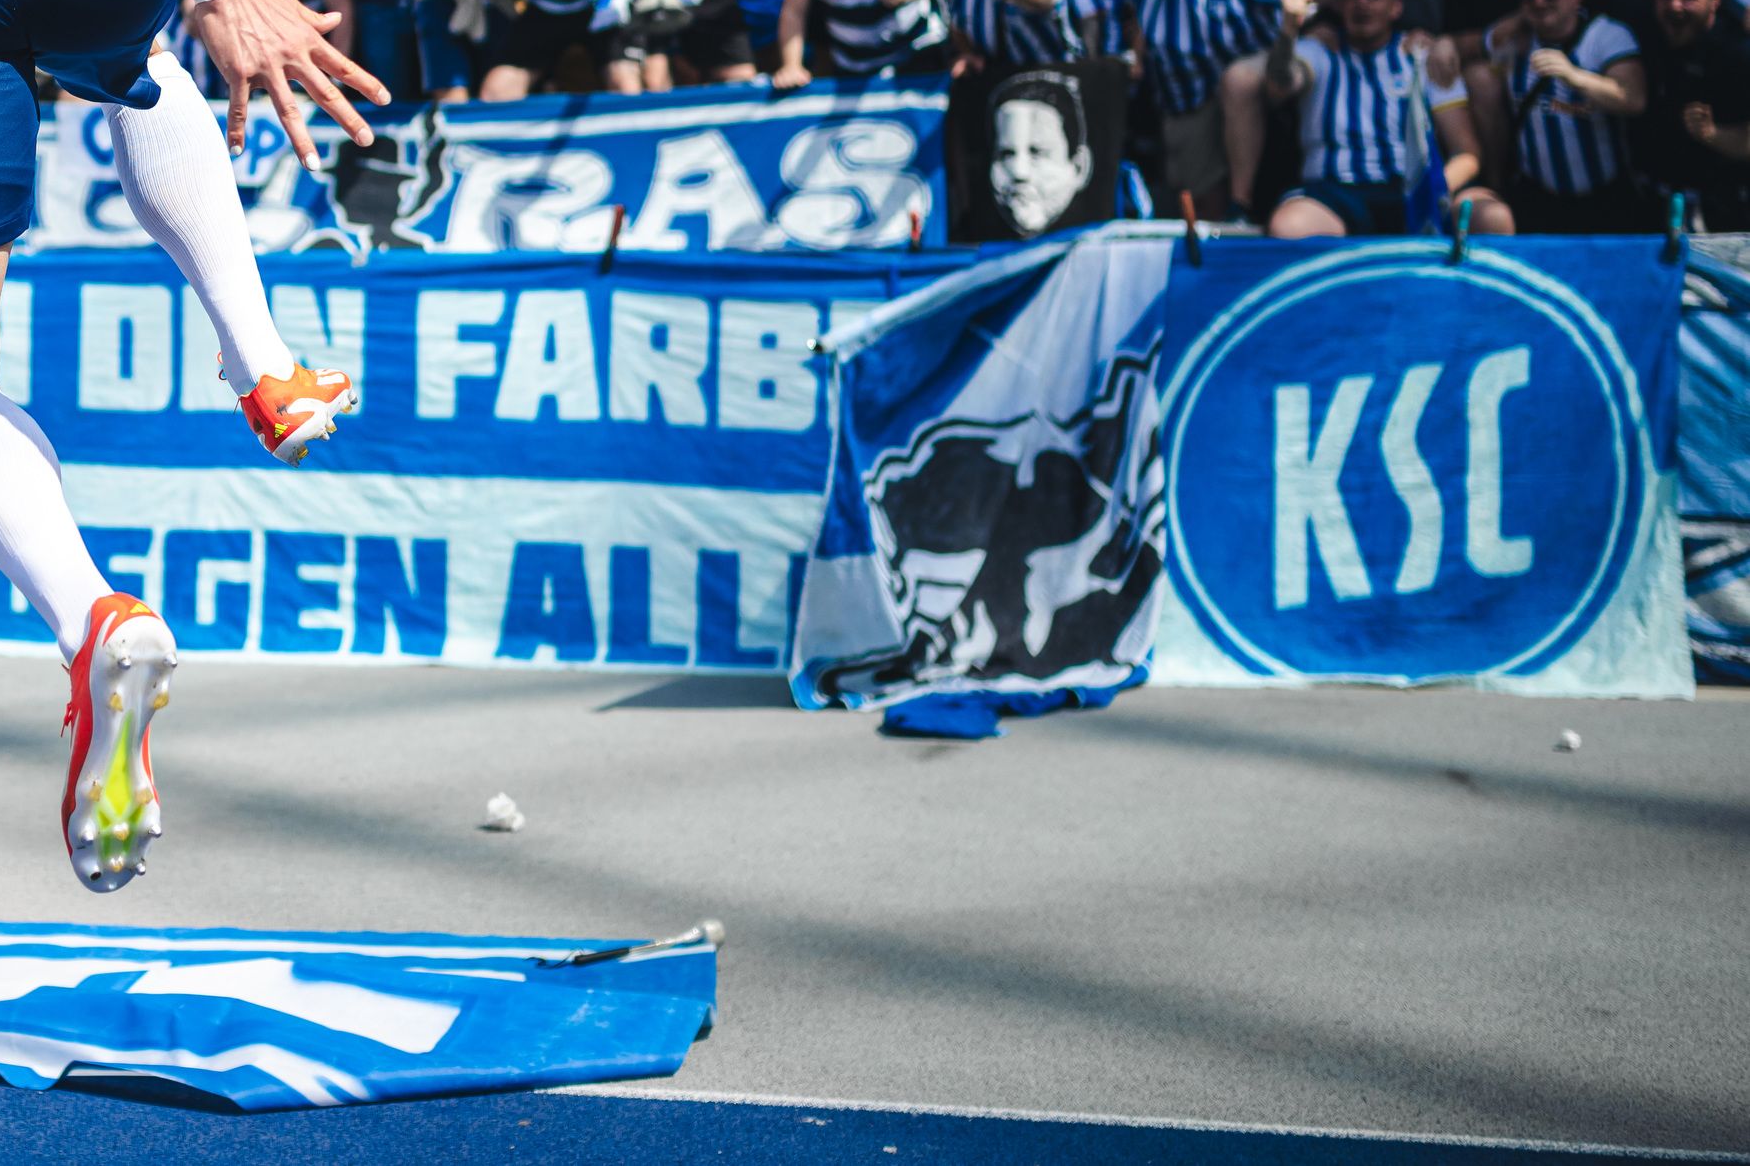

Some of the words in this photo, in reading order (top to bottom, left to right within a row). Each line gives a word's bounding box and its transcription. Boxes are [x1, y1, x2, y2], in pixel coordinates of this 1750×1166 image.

[416, 289, 886, 432] FARB
[1274, 344, 1534, 611] KSC
[495, 540, 806, 670] ALL
